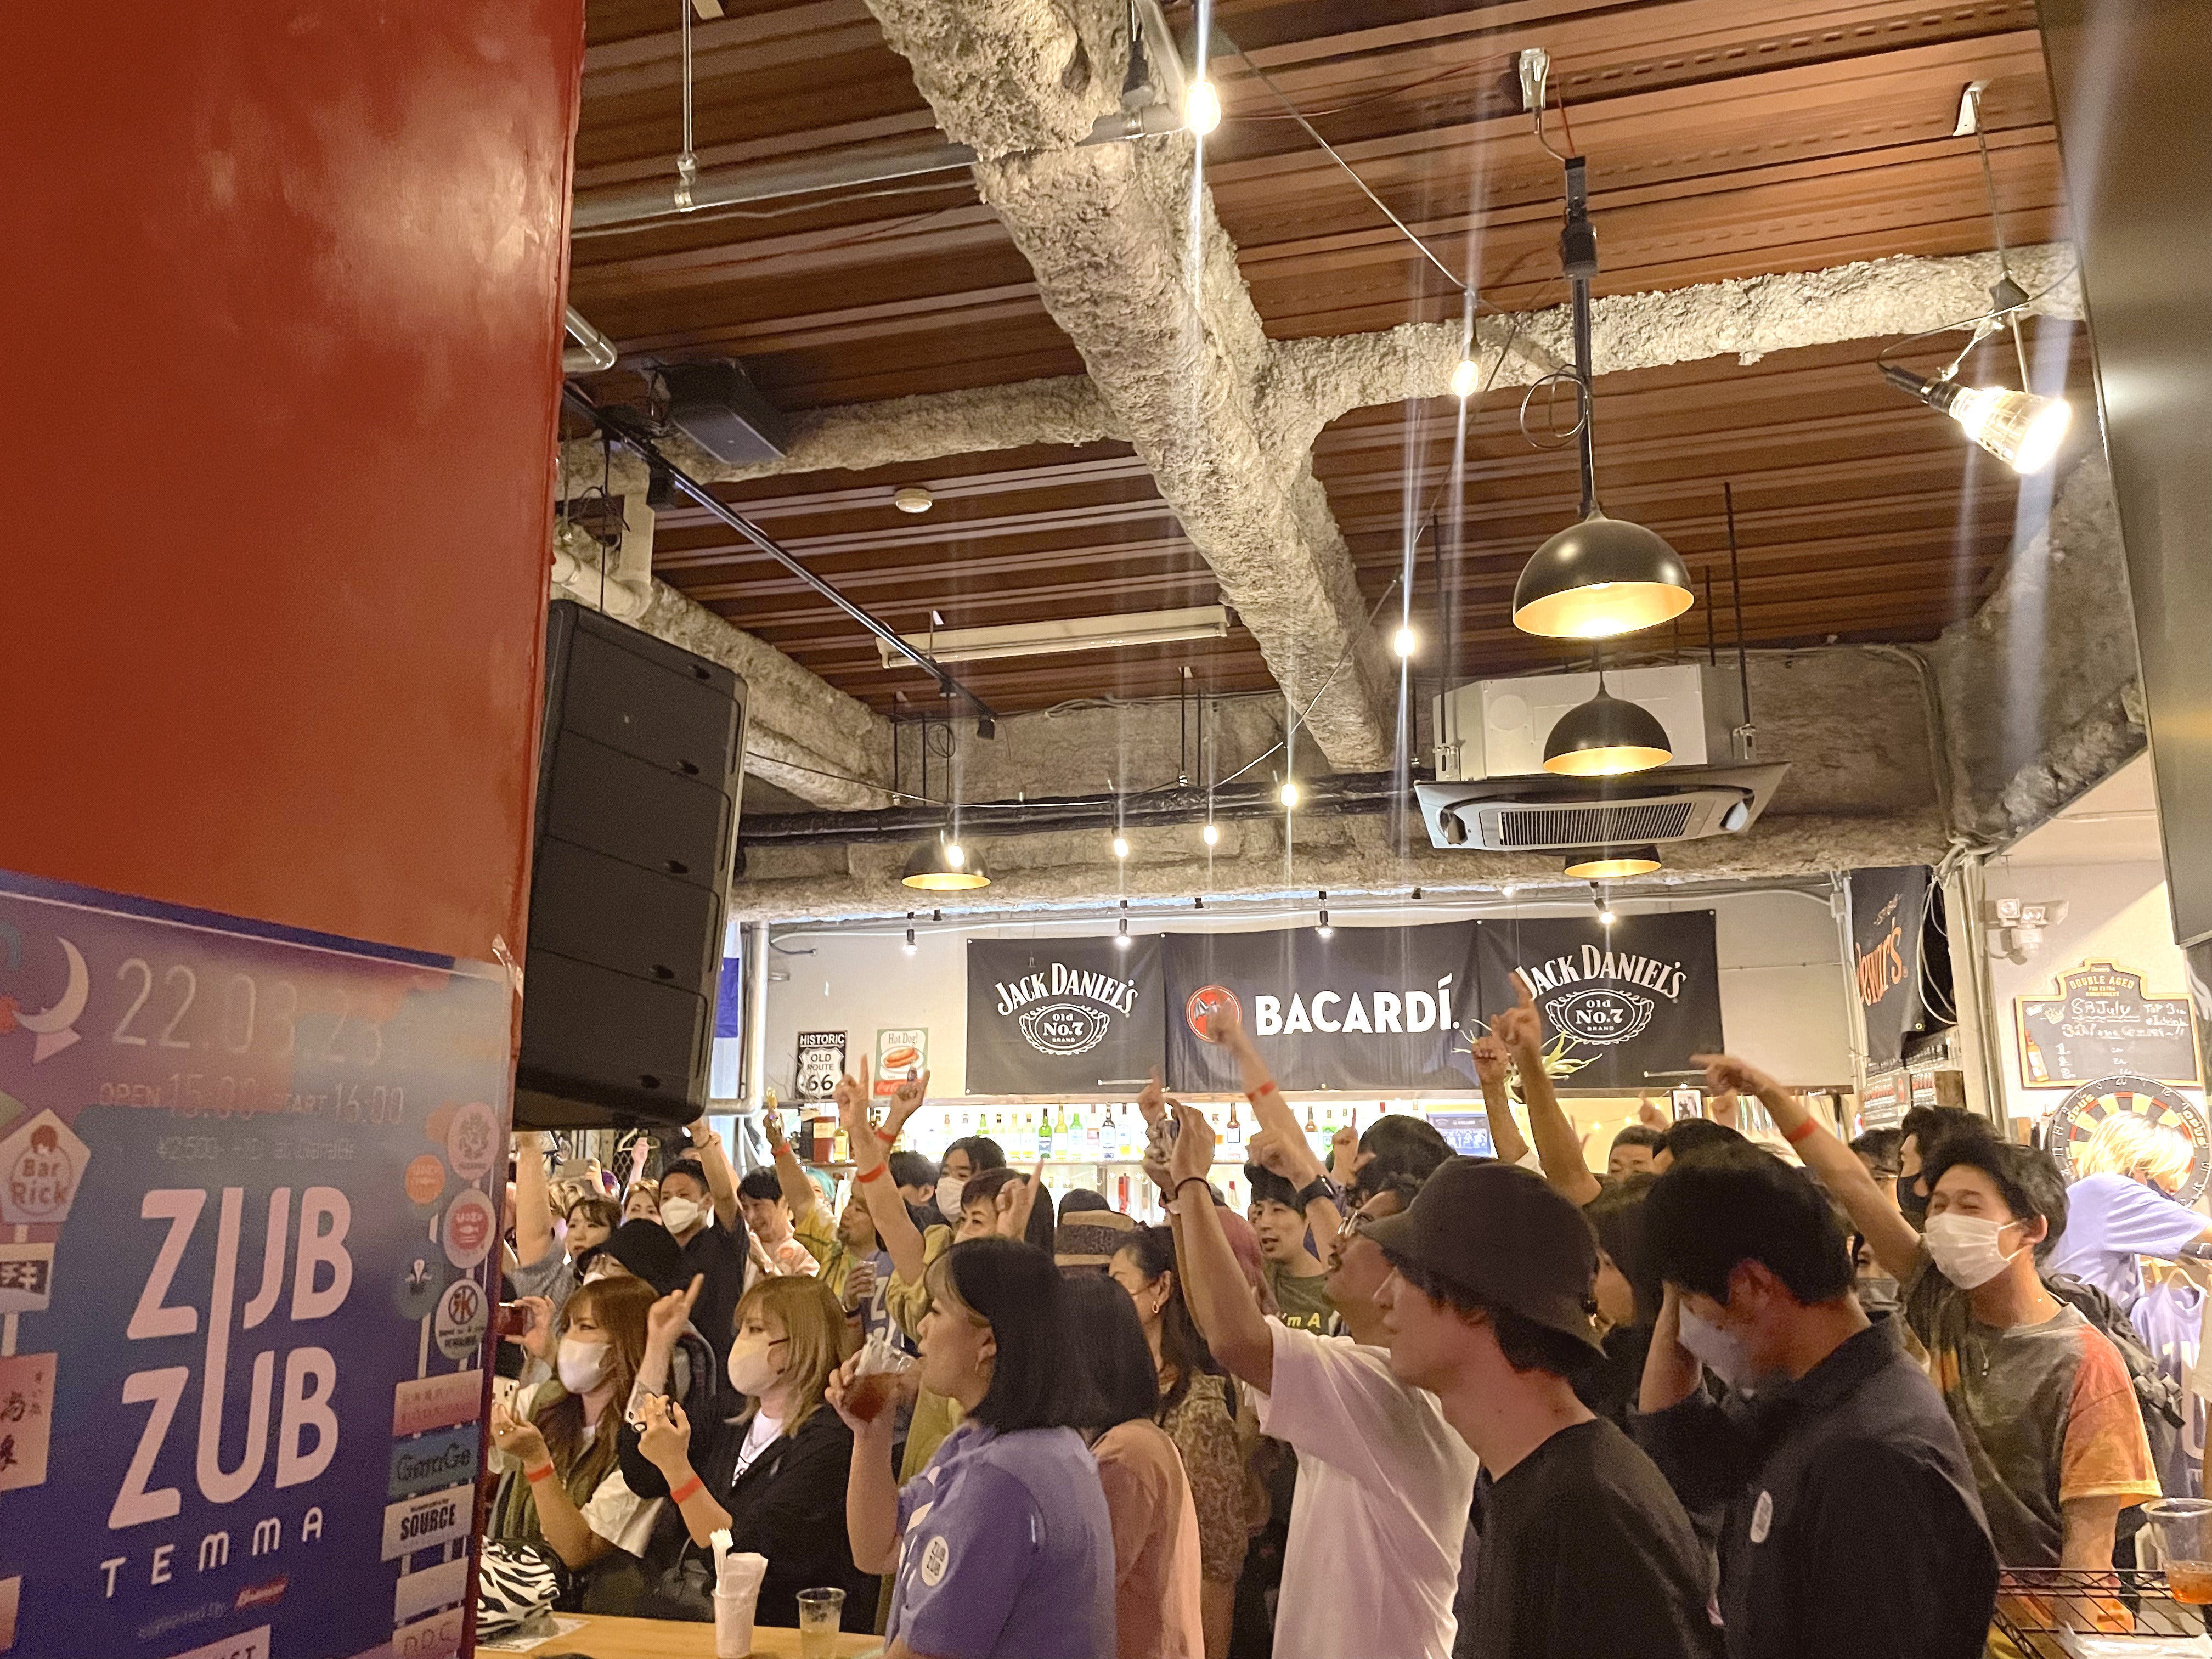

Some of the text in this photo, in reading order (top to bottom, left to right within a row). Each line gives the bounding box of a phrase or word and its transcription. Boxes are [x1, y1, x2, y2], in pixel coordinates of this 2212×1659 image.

[1515, 944, 1688, 1001] JACK DANIEL'S
[995, 962, 1138, 1015] JACK DANIEL'S
[2069, 975, 2134, 990] DOUBLE AGED
[1255, 973, 1453, 1036] BACARDÍ
[1586, 999, 1611, 1008] Old
[1052, 1013, 1073, 1022] Old
[1576, 1008, 1624, 1024] No.7
[1043, 1022, 1084, 1036] No.7
[800, 1034, 845, 1045] HISTORIC
[888, 1033, 901, 1044] Hot
[811, 1053, 831, 1062] OLD
[806, 1074, 834, 1091] 66
[23, 1158, 60, 1177] Bar
[11, 1180, 67, 1205] Rick
[1308, 1312, 1321, 1328] A
[400, 1503, 456, 1541] SOURCE
